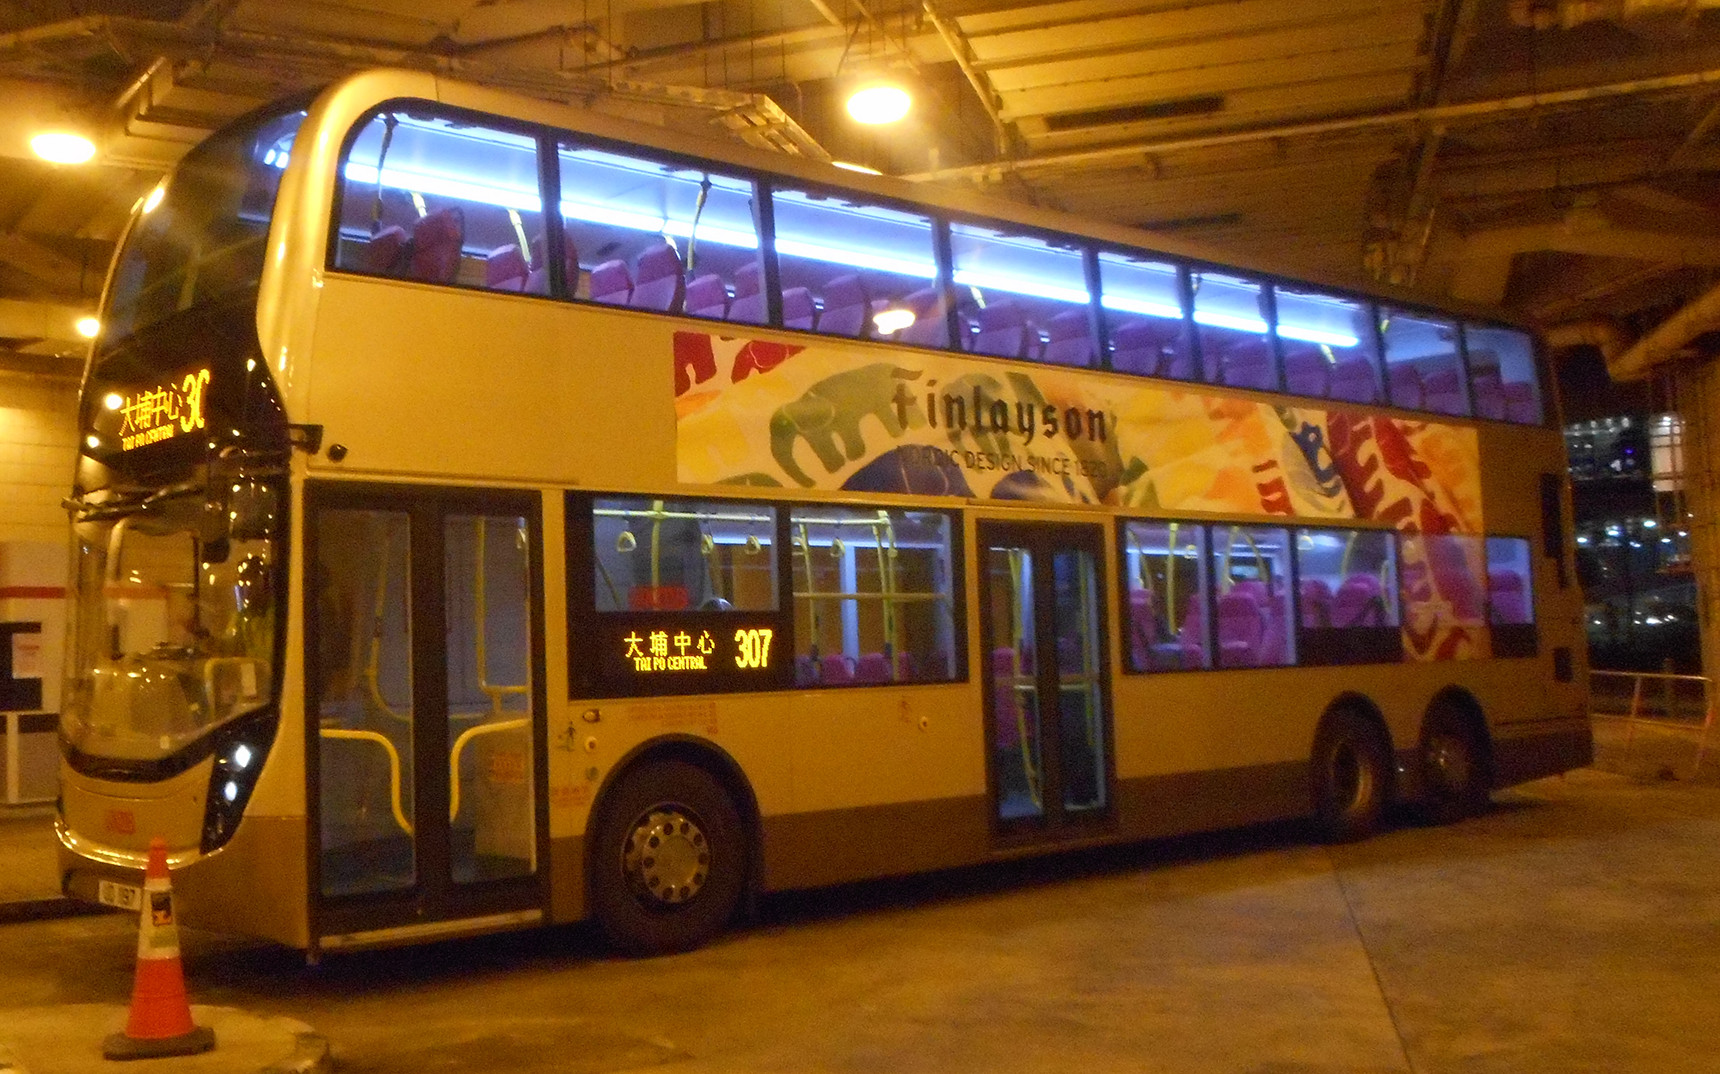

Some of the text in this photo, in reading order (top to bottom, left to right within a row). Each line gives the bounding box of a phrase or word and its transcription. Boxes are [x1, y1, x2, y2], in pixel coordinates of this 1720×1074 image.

[890, 367, 1108, 446] Finlayson
[897, 444, 960, 468] RDIC
[965, 450, 1024, 472] DESIGN
[1027, 455, 1072, 477] SINCE
[624, 629, 773, 668] 大埔中心 307
[633, 655, 708, 671] TAI PO CENTRAL
